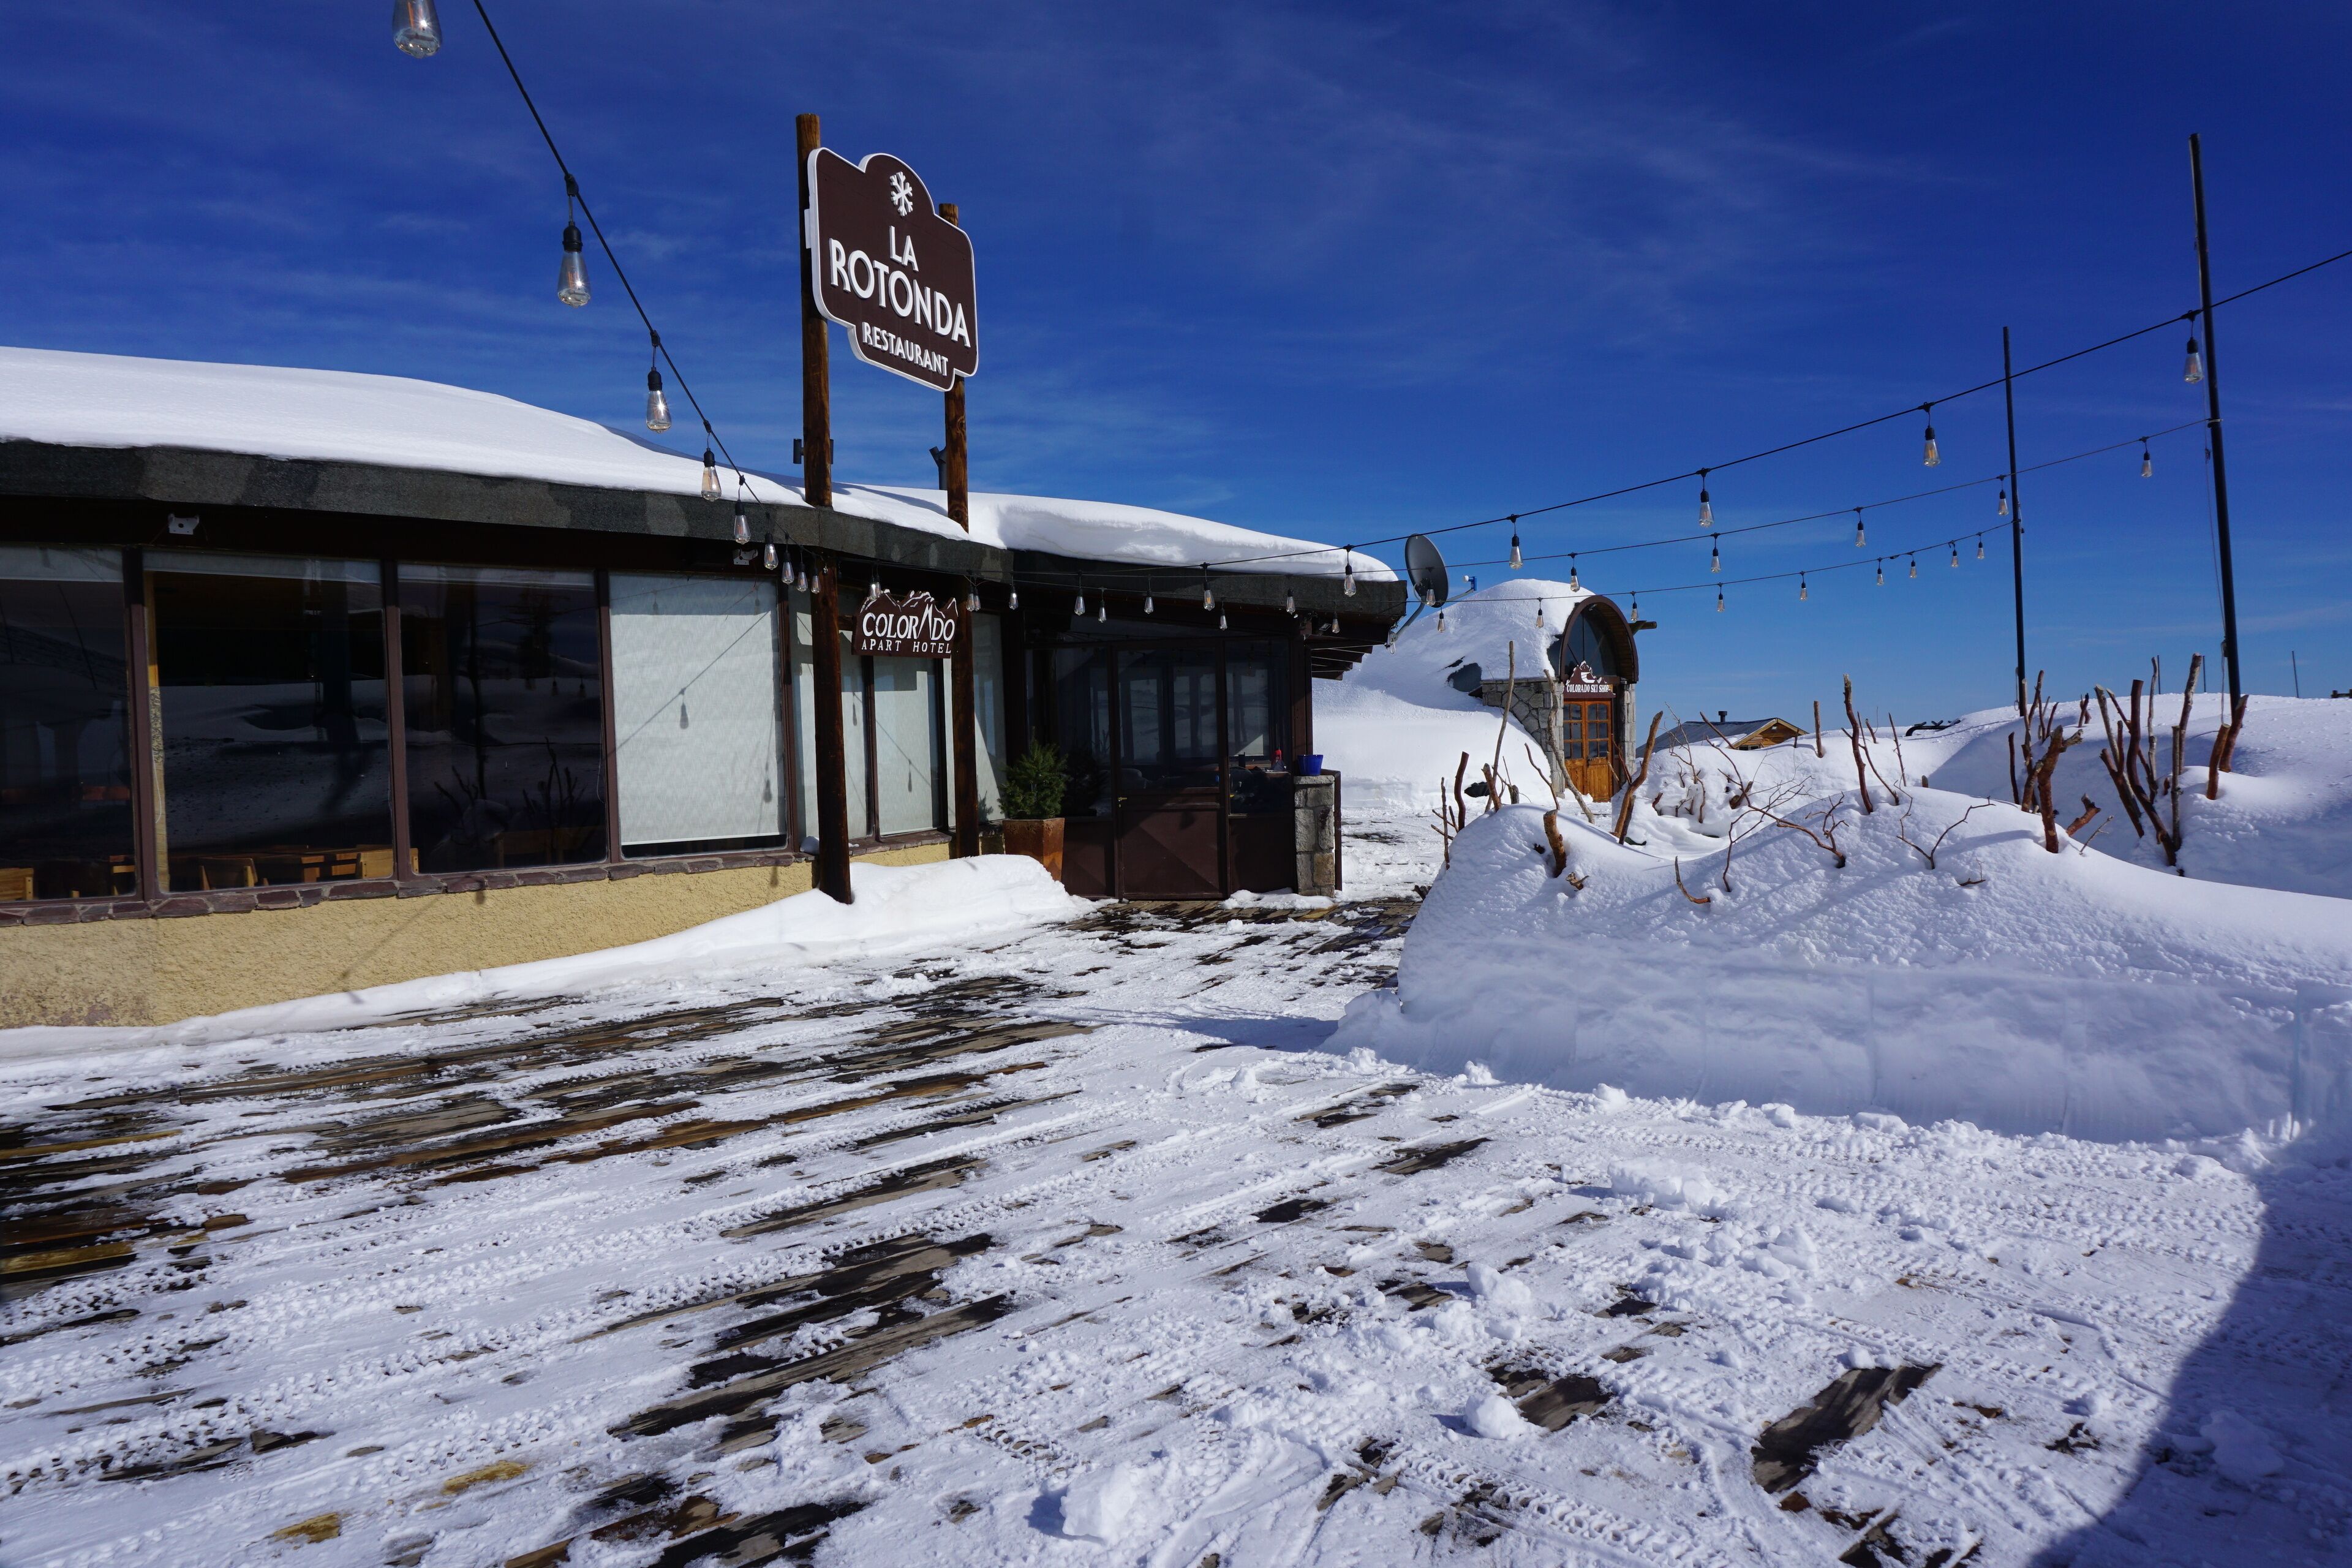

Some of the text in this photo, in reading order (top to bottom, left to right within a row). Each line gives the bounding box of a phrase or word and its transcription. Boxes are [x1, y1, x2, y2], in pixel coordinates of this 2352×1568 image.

[889, 225, 919, 272] LA
[829, 238, 971, 348] ROTONDA
[862, 322, 948, 377] RESTAURANT
[862, 603, 956, 641] COLORADO
[861, 639, 951, 654] APART HOTEL
[1566, 684, 1590, 693] COLORADO
[1599, 684, 1609, 693] SHOP
